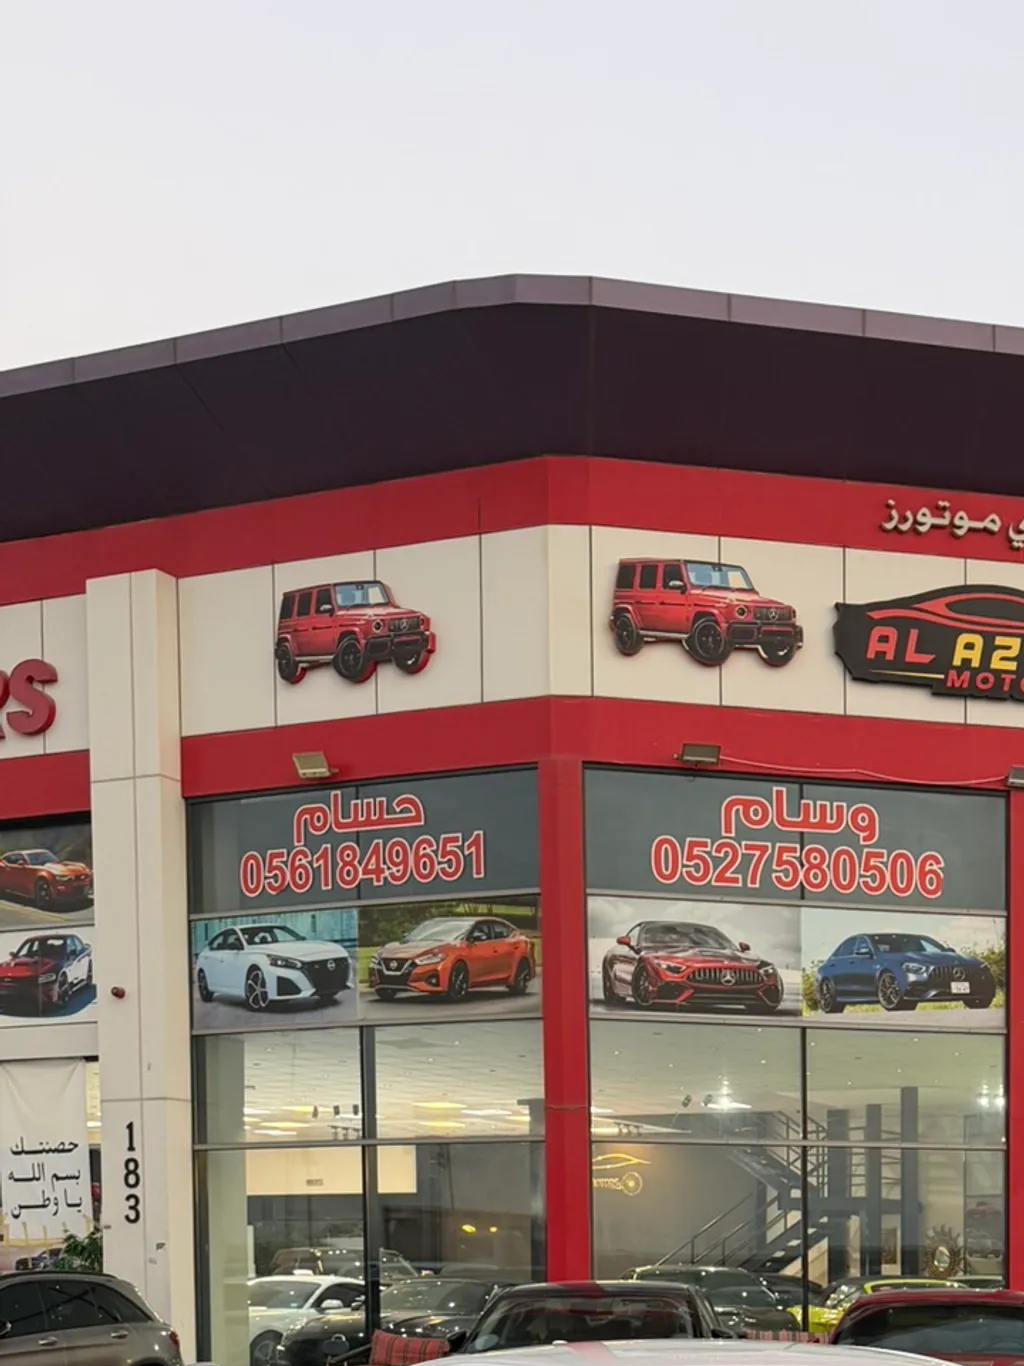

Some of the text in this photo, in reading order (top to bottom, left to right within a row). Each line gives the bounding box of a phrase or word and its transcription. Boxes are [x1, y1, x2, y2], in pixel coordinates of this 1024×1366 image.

[881, 499, 1002, 537] موتورز
[866, 625, 936, 664] AL
[0, 658, 58, 740] S
[293, 790, 425, 846] حسام
[721, 786, 879, 845] وسام
[240, 830, 485, 898] 0561849651
[651, 835, 945, 899] 0527580506
[8, 1162, 81, 1192] بسم الله
[11, 1188, 83, 1219] يا وطن
